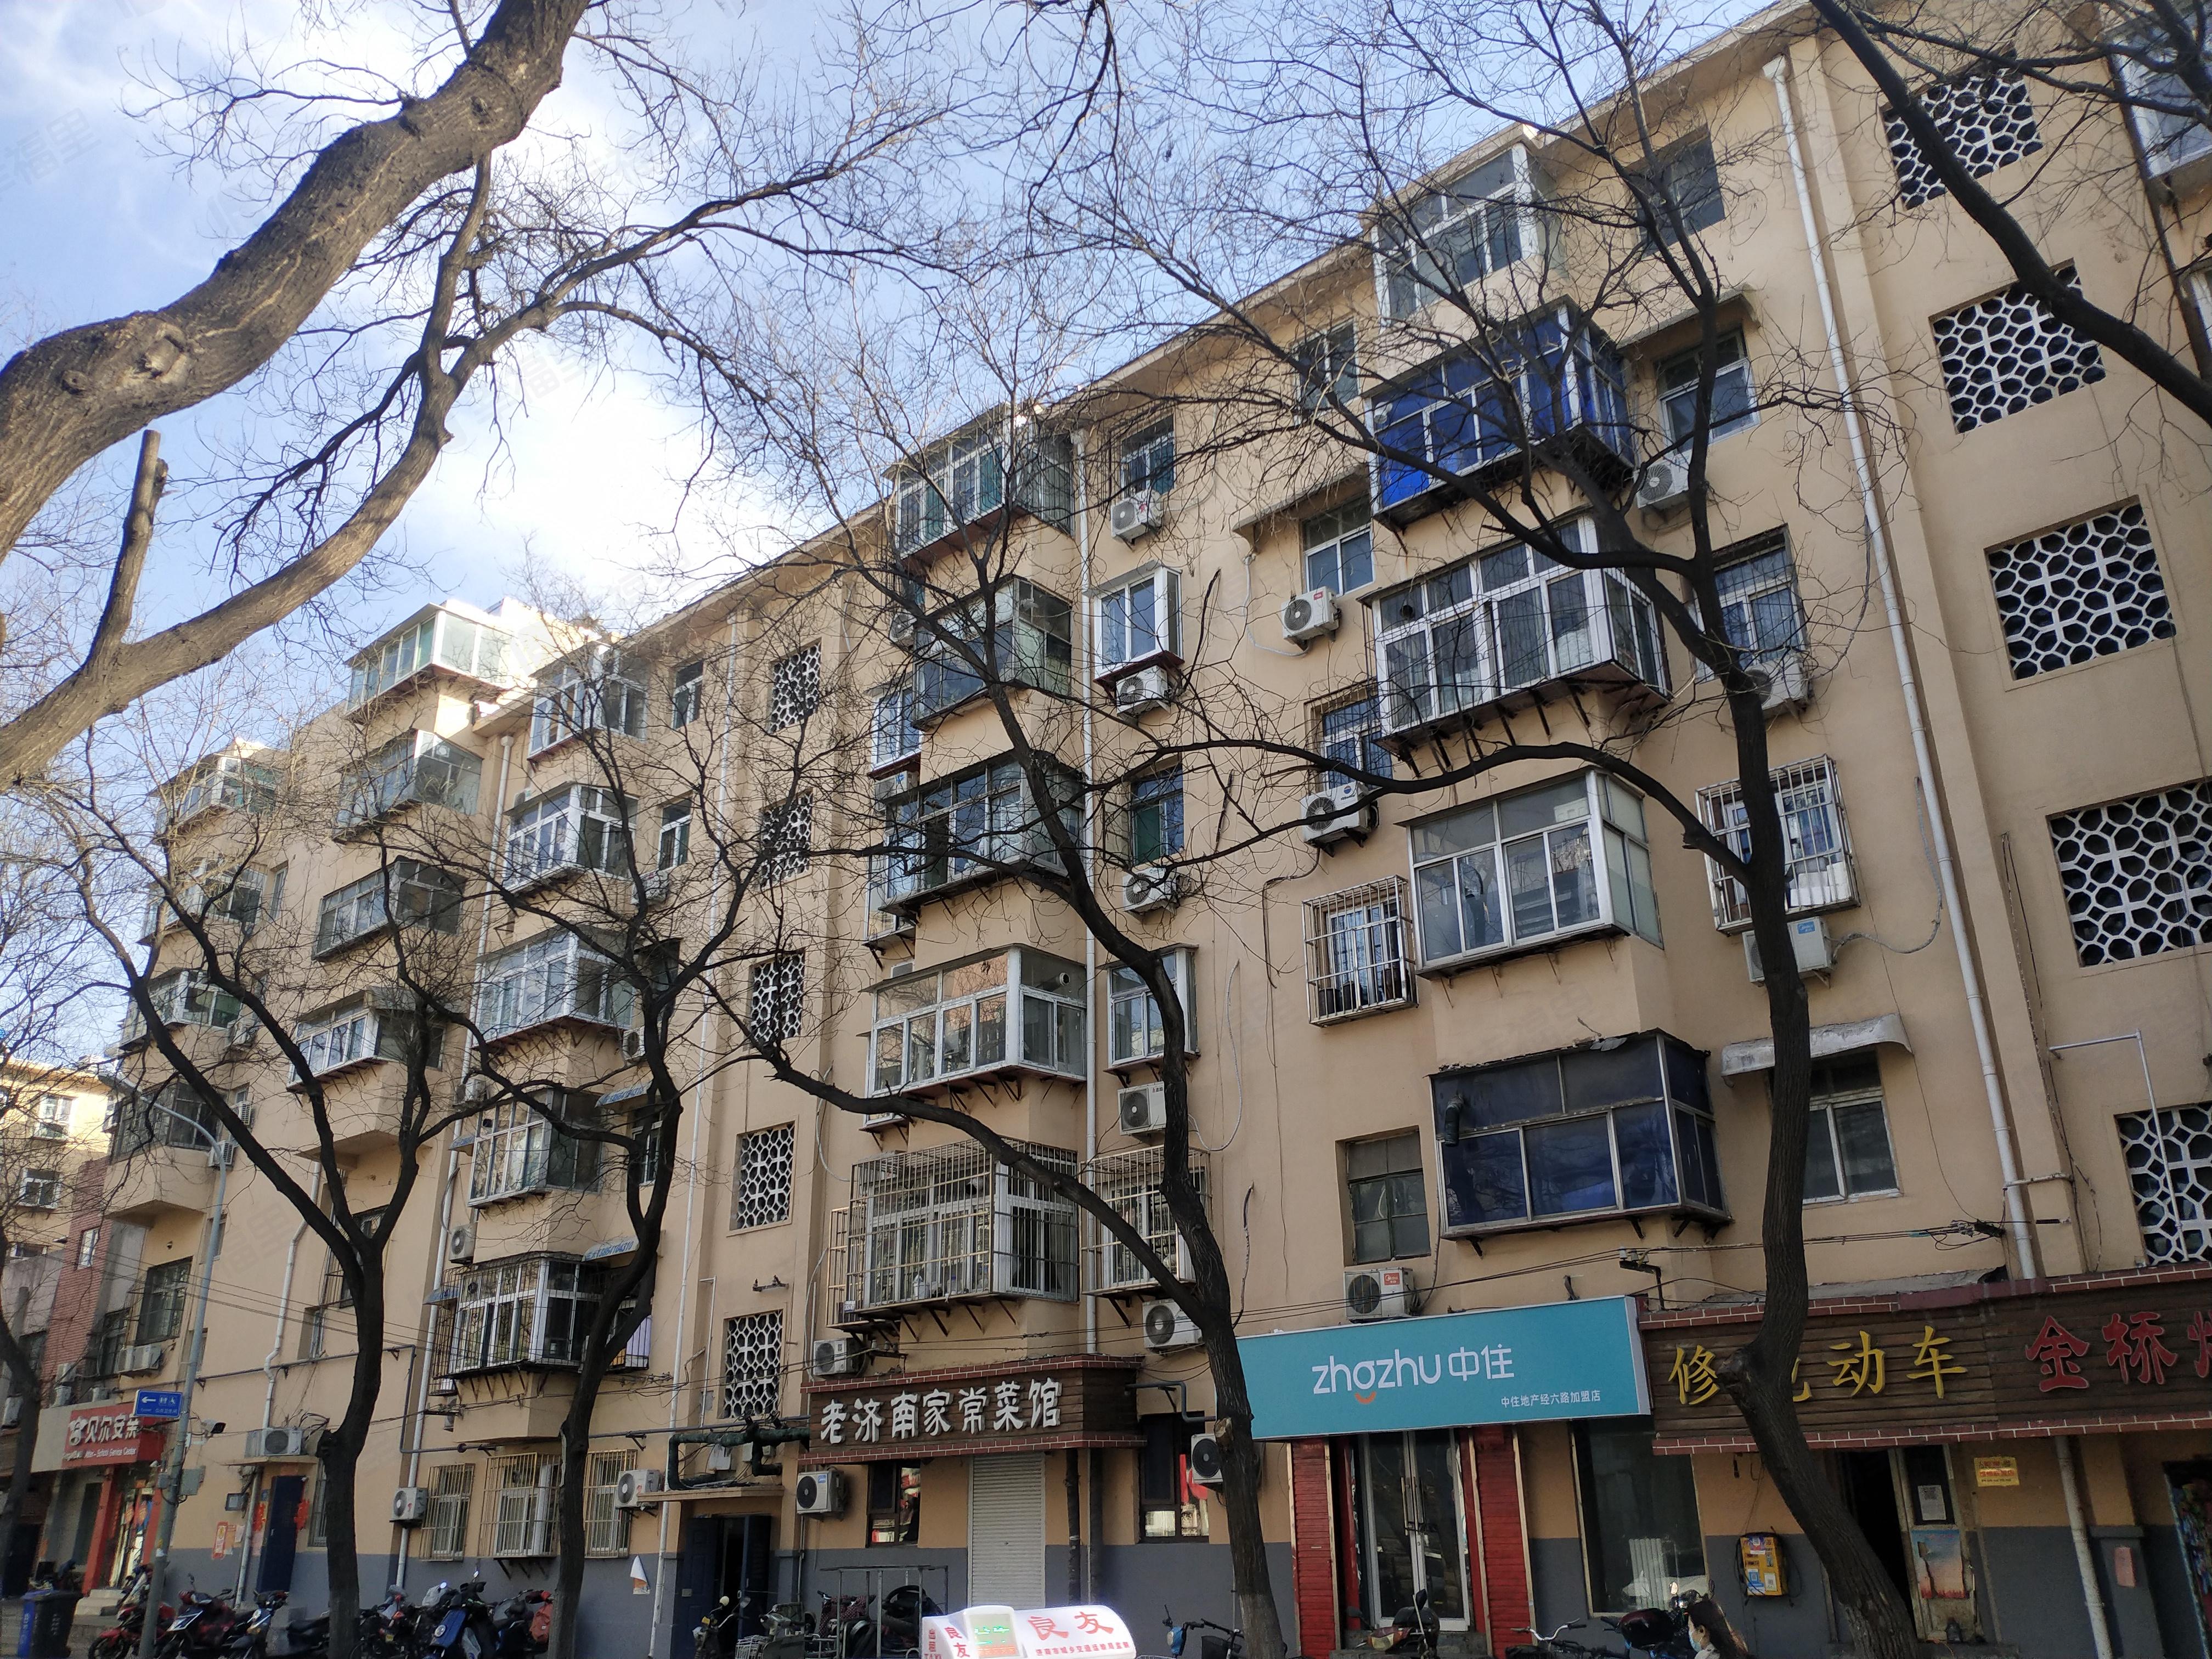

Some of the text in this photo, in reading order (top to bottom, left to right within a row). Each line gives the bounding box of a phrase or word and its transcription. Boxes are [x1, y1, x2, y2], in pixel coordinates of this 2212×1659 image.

[1448, 1344, 1515, 1381] 中住
[1668, 1325, 1968, 1405] 修动车
[820, 1376, 1063, 1444] 老济南家常菜馆
[1500, 1390, 1601, 1408] 中住地产经六路加盟店
[944, 1626, 970, 1658] 良友
[1028, 1611, 1114, 1640] 良友
